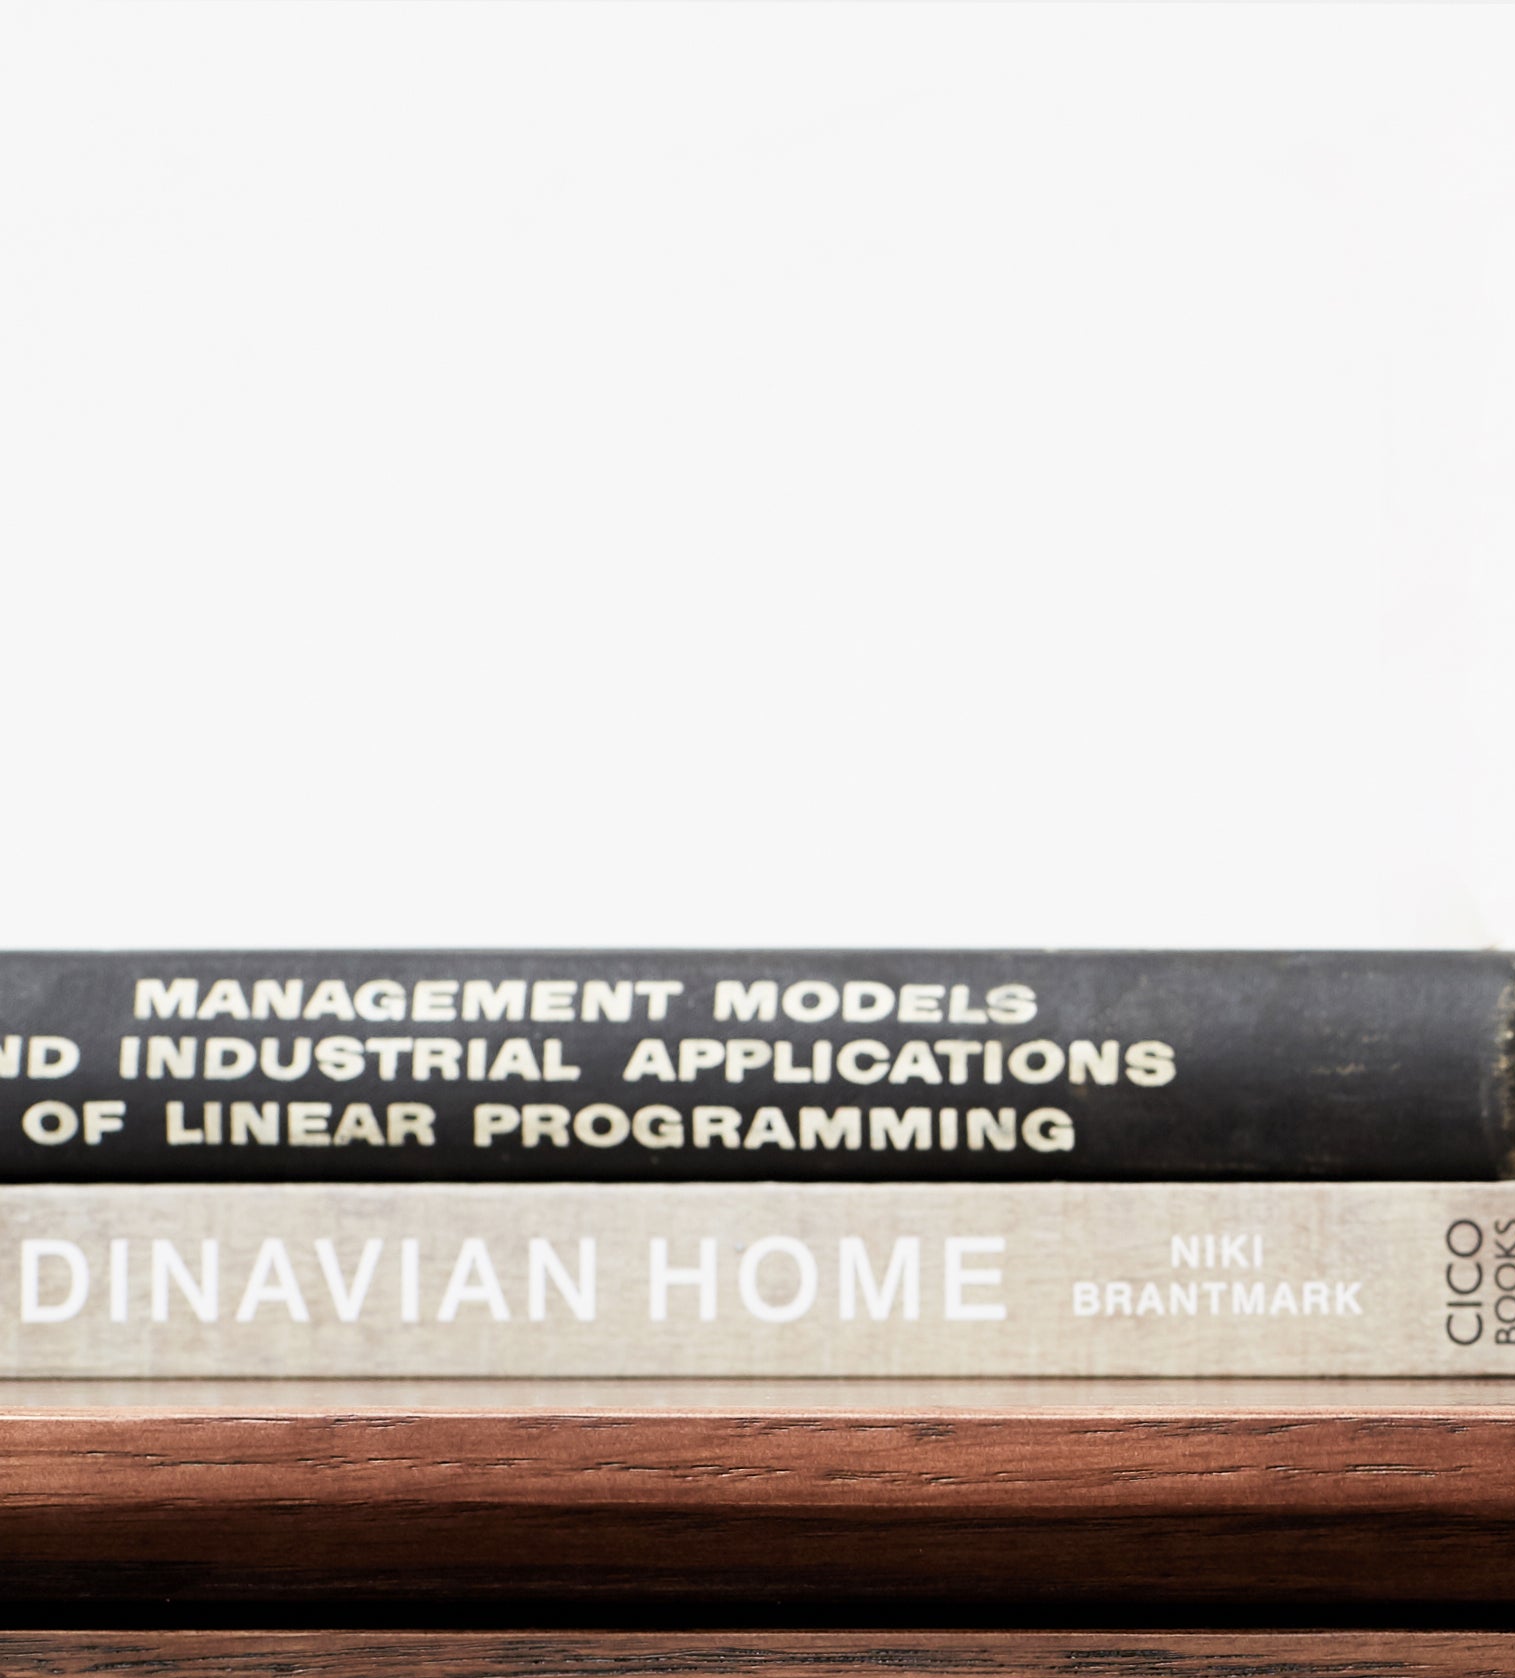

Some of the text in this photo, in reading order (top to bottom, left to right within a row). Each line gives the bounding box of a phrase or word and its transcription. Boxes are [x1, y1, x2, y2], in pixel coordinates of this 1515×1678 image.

[134, 978, 1038, 1025] MANAGEMENT MODELS
[120, 1036, 580, 1081] INDUSTRIAL
[623, 1039, 1175, 1086] APPLICATIONS
[23, 1101, 1074, 1151] OF LINEAR PROGRAMMING
[1170, 1233, 1264, 1269] NIKI
[20, 1235, 1006, 1323] DINAVIAN HOME
[1072, 1280, 1364, 1317] BRANTMARK
[1445, 1217, 1485, 1347] CICO
